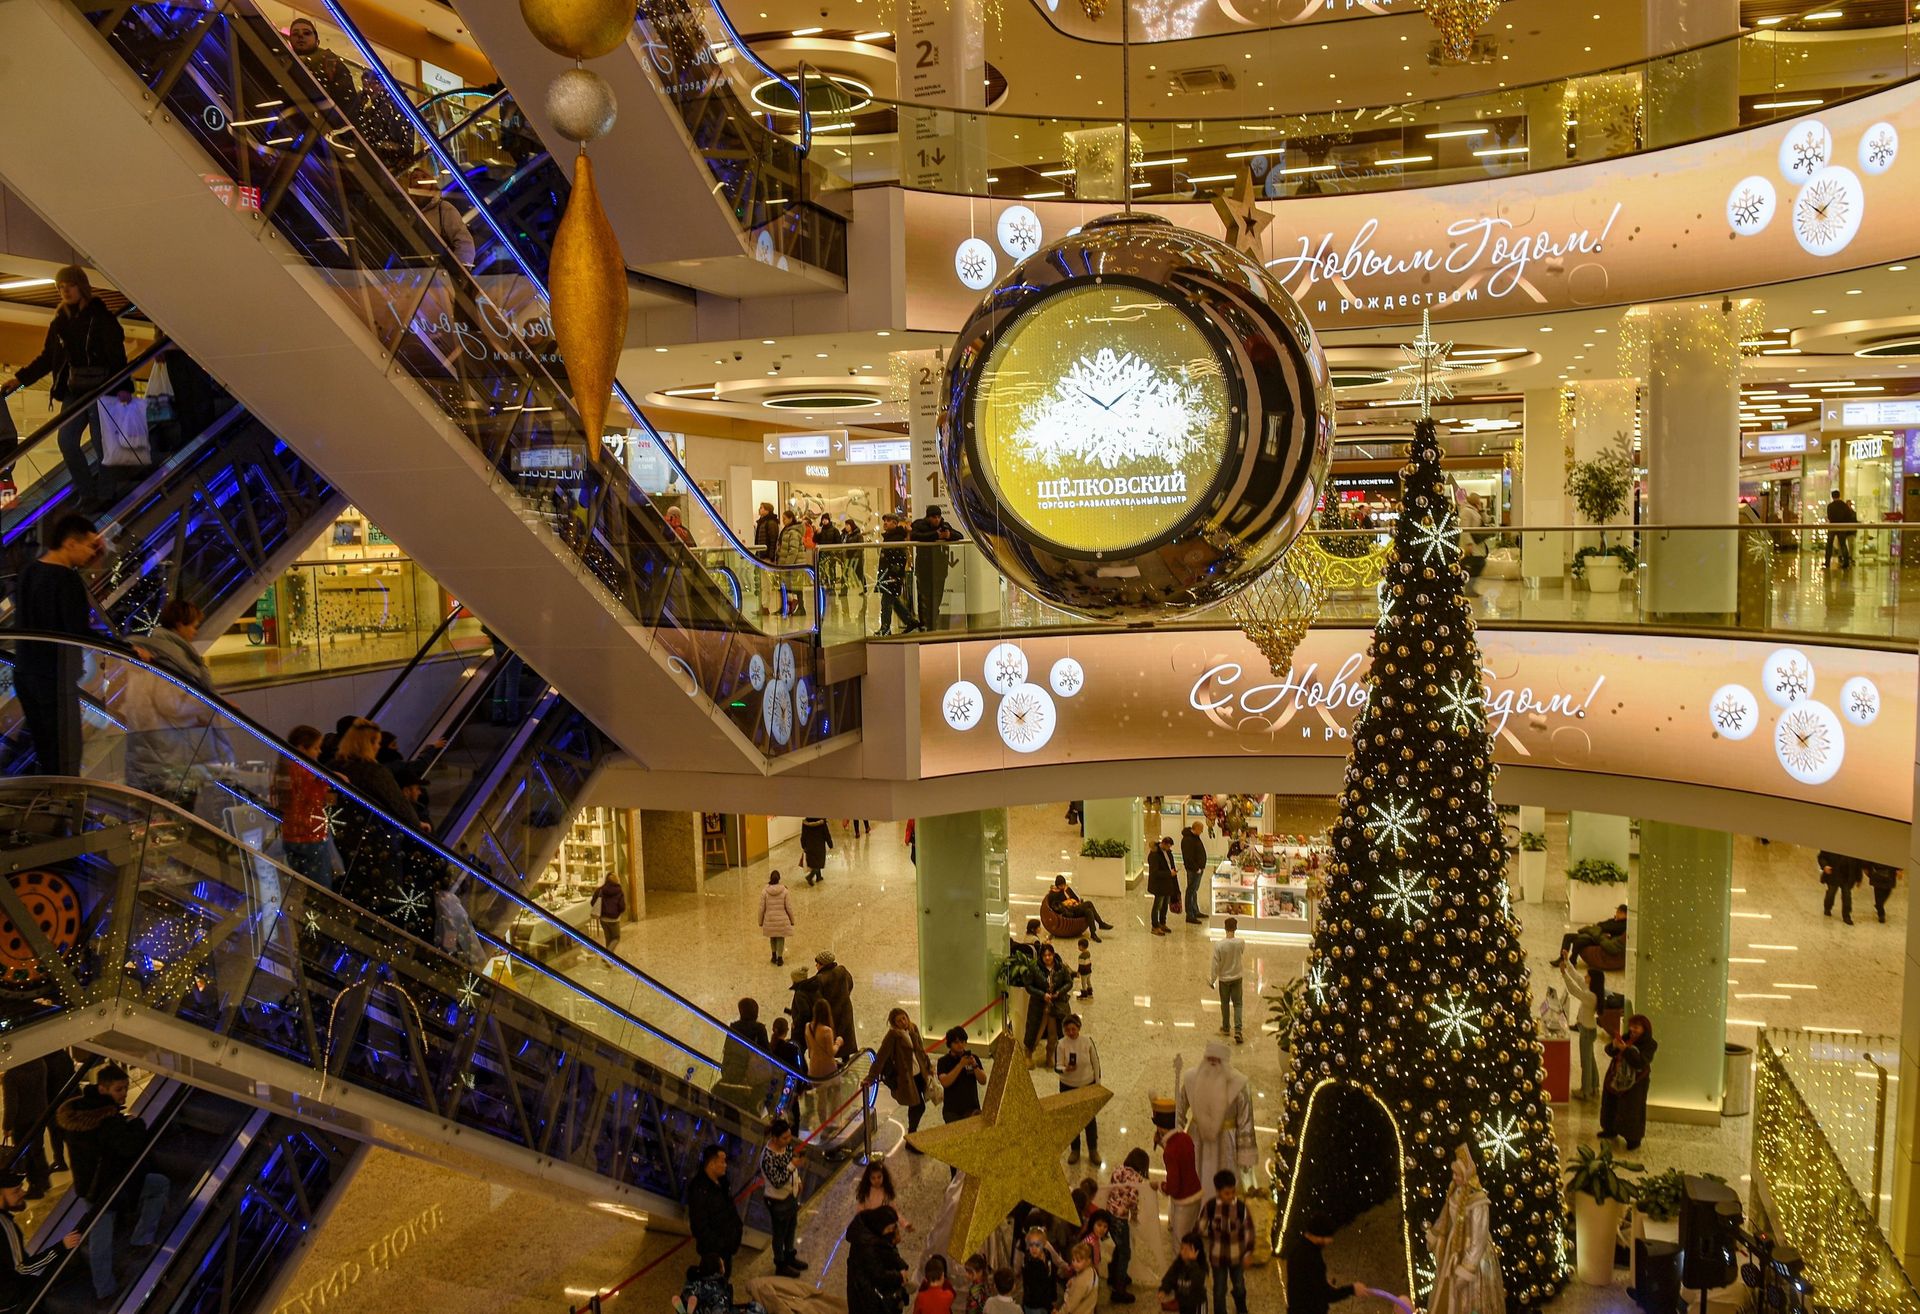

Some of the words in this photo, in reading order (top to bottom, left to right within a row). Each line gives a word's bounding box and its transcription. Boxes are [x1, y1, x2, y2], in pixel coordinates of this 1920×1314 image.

[916, 40, 933, 68] 2
[917, 149, 925, 168] 1
[1265, 218, 1442, 285] Новым
[1446, 202, 1621, 298] Годом!
[1318, 300, 1326, 312] и
[1341, 289, 1479, 314] рождеством
[920, 367, 931, 385] 2
[1849, 439, 1883, 459] CHESTER
[927, 471, 939, 498] 1
[1038, 471, 1187, 500] ЩЁЛКОВСКИЙ
[1038, 496, 1160, 510] ТОРГОВО-РАЗВЛЕКАТЕЛЬНЫЙ
[1161, 496, 1187, 504] ЦЕНТР
[1240, 653, 1370, 713] Новы
[1482, 668, 1605, 737] одом!
[1302, 727, 1311, 738] и
